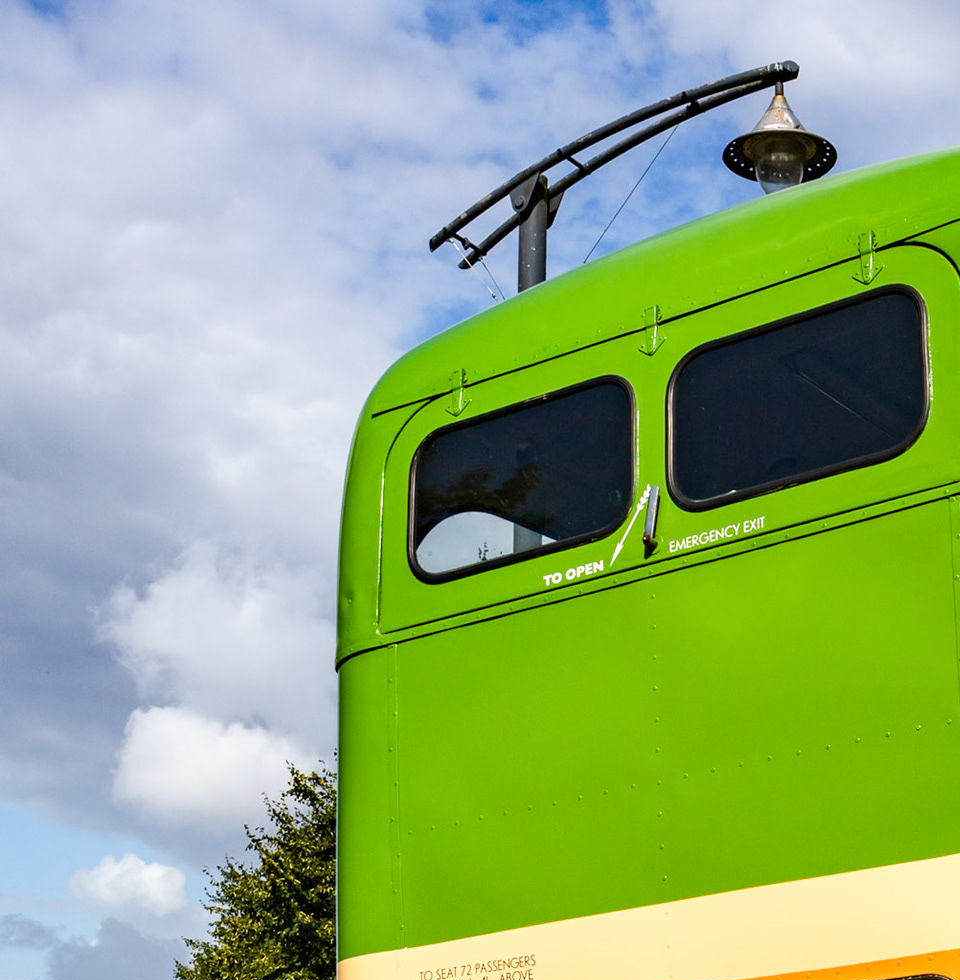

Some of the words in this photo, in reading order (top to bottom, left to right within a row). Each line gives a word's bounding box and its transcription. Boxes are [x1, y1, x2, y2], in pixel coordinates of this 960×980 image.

[669, 523, 740, 553] EMERGENCY
[743, 516, 766, 533] EXIT
[542, 572, 562, 587] TO
[565, 560, 604, 580] OPEN
[436, 966, 457, 980] SEAT
[461, 964, 472, 977] 72
[475, 954, 537, 974] PASSENGERS
